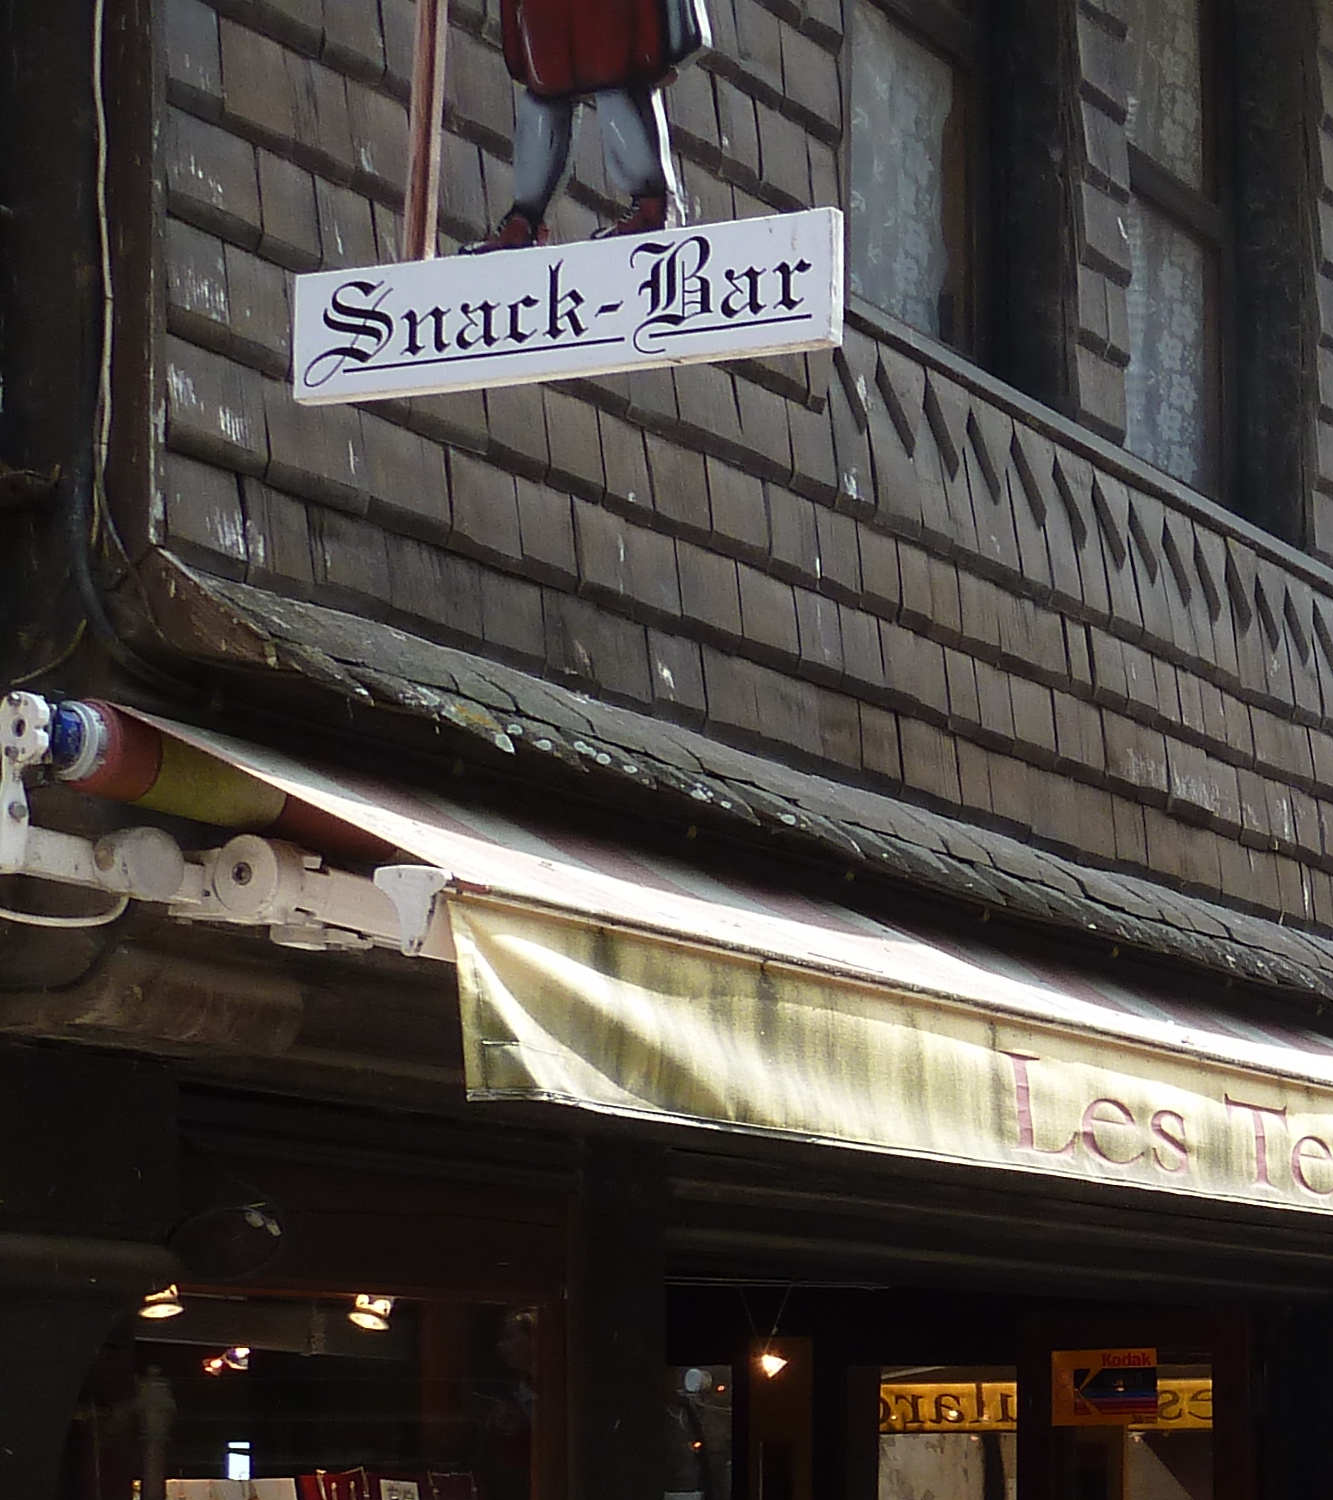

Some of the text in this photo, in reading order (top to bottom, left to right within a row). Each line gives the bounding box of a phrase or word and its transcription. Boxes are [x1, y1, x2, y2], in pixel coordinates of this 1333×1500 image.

[303, 235, 812, 388] Snack-Bar
[1000, 1049, 1190, 1176] Les
[1102, 1352, 1151, 1367] Kodak
